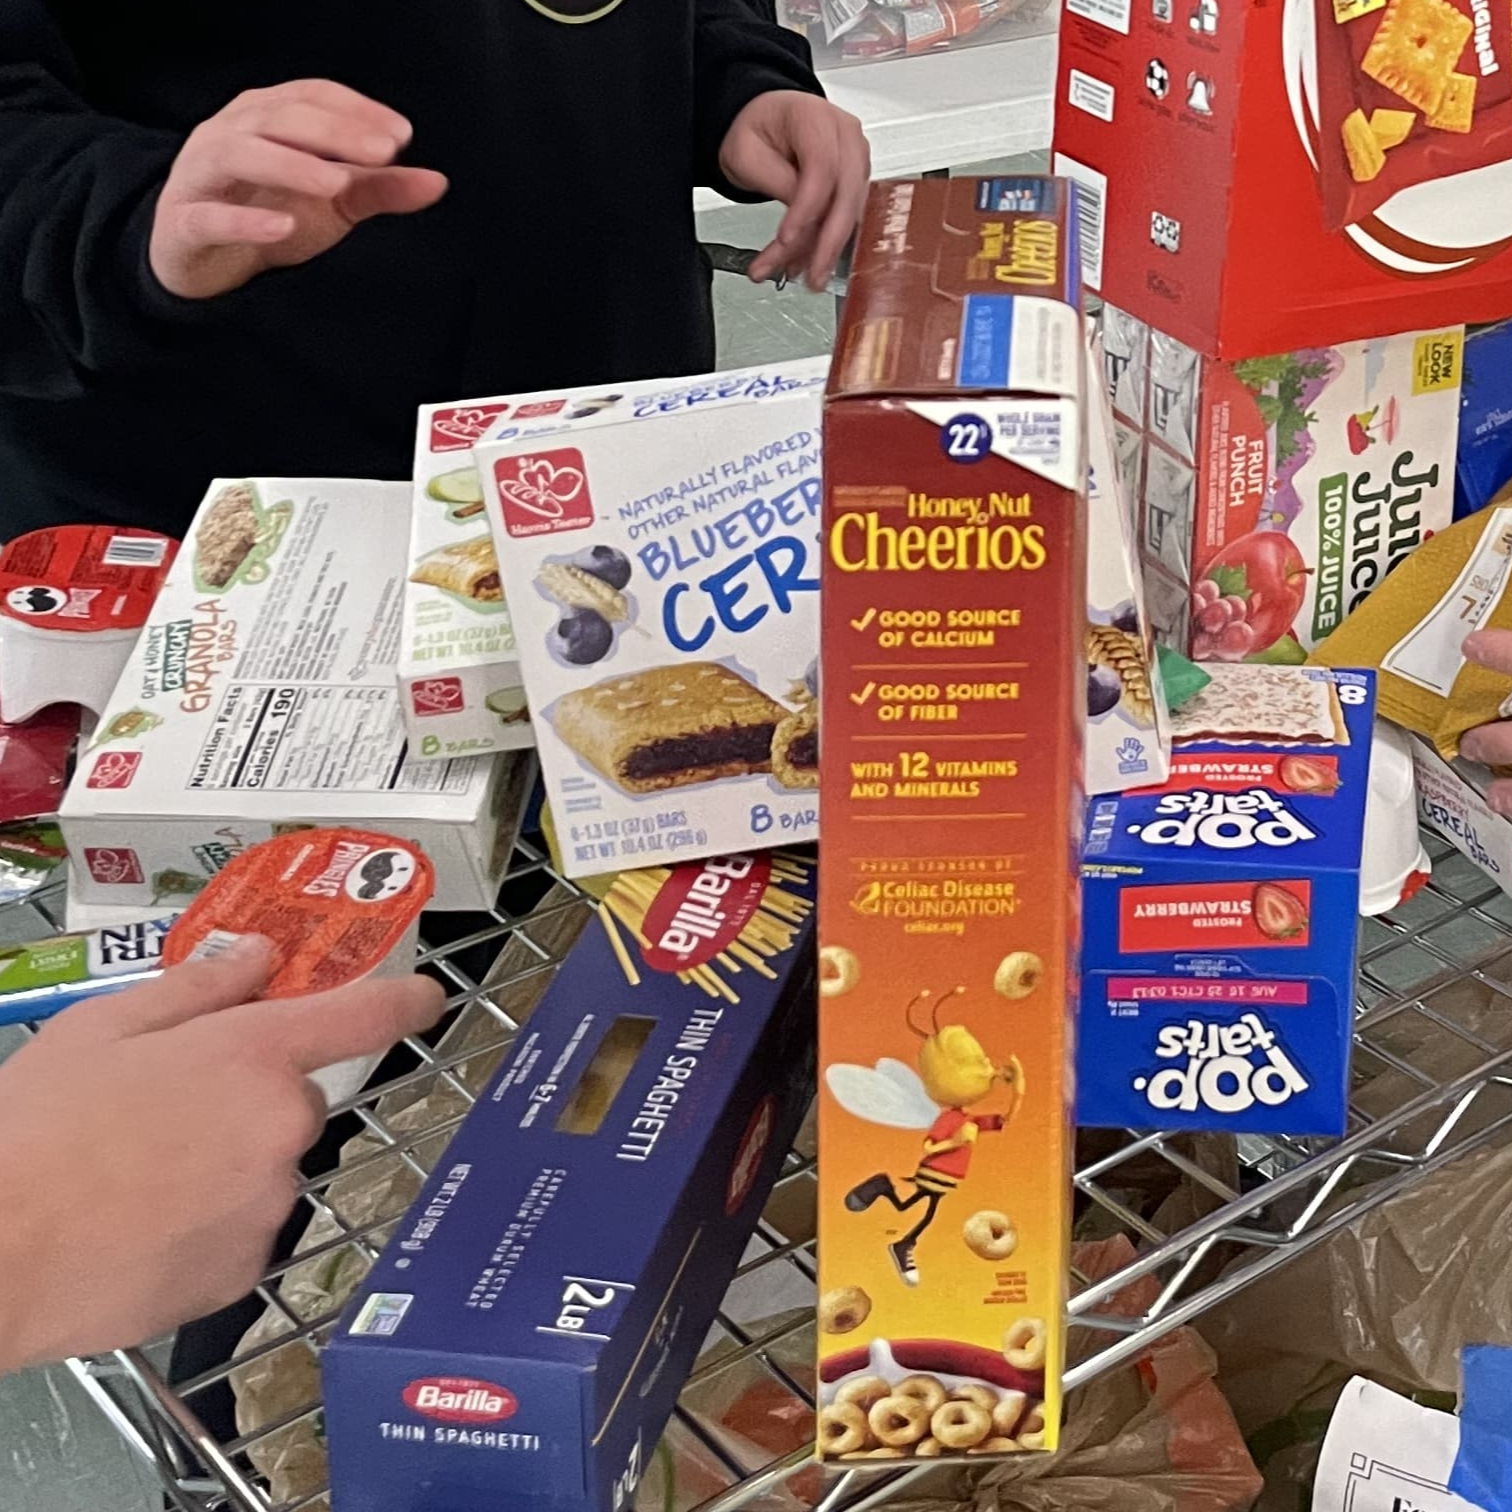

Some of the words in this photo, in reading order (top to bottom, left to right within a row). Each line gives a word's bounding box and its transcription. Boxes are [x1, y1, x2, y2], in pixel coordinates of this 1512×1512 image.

[1430, 342, 1442, 385] LOOK
[1442, 344, 1453, 378] NEW
[632, 375, 788, 419] CEREAL
[617, 466, 718, 522] NATURALLY
[720, 431, 814, 479] FLAVORED
[1230, 435, 1246, 506] PUNCH
[1249, 439, 1264, 496] FRUIT
[627, 506, 690, 541] OTHER
[692, 473, 776, 515] NATURAL
[908, 493, 987, 525] Honey
[989, 492, 1031, 518] Nut
[1322, 485, 1343, 551] 100%
[829, 511, 1048, 572] Cheerios
[1318, 555, 1339, 629] JUICE
[878, 630, 906, 648] OF
[910, 629, 995, 648] CALCIUM
[879, 610, 941, 628] GOOD
[947, 609, 1021, 627] SOURCE
[145, 624, 163, 666] HONEY
[165, 620, 189, 691] CRUNCHY
[180, 596, 223, 713] GRANOLA
[216, 620, 237, 664] BARS
[141, 675, 157, 701] OAT
[878, 683, 940, 701] GOOD
[946, 682, 1020, 701] SOURCE
[1338, 684, 1367, 705] 8
[878, 704, 904, 721] OF
[909, 704, 959, 721] FIBER
[190, 725, 227, 789] Nutrition
[217, 684, 244, 724] Facts
[245, 729, 281, 788] Calories
[271, 686, 296, 720] 190
[421, 735, 441, 756] 8
[850, 761, 894, 779] WITH
[898, 752, 929, 779] 12
[936, 760, 1018, 778] VITAMINS
[850, 781, 889, 799] AND
[894, 781, 980, 799] MINERALS
[1155, 789, 1283, 816] tarts
[750, 803, 774, 834] 8
[780, 809, 819, 832] BAR
[1424, 798, 1483, 850] CEREAL
[302, 840, 370, 898] PRINGLES
[882, 880, 939, 898] Celiac
[943, 879, 1015, 898] Disease
[658, 854, 756, 956] Barilla
[882, 898, 1015, 918] FOUNDATION
[1133, 901, 1252, 918] STRAWBERRY
[1192, 917, 1242, 928] FROSTED
[679, 1007, 724, 1051] THIN
[1155, 1013, 1274, 1058] tarts
[616, 1052, 697, 1161] SPAGHETTI
[516, 1168, 553, 1220] PREMIUM
[521, 1169, 567, 1238] CAREFULLY
[490, 1223, 521, 1264] DURUM
[466, 1268, 496, 1308] WHEAT
[480, 1244, 525, 1308] SELECTED
[415, 1385, 503, 1414] Barilla
[379, 1422, 426, 1441] THIN
[434, 1426, 540, 1452] SPAGHETTI
